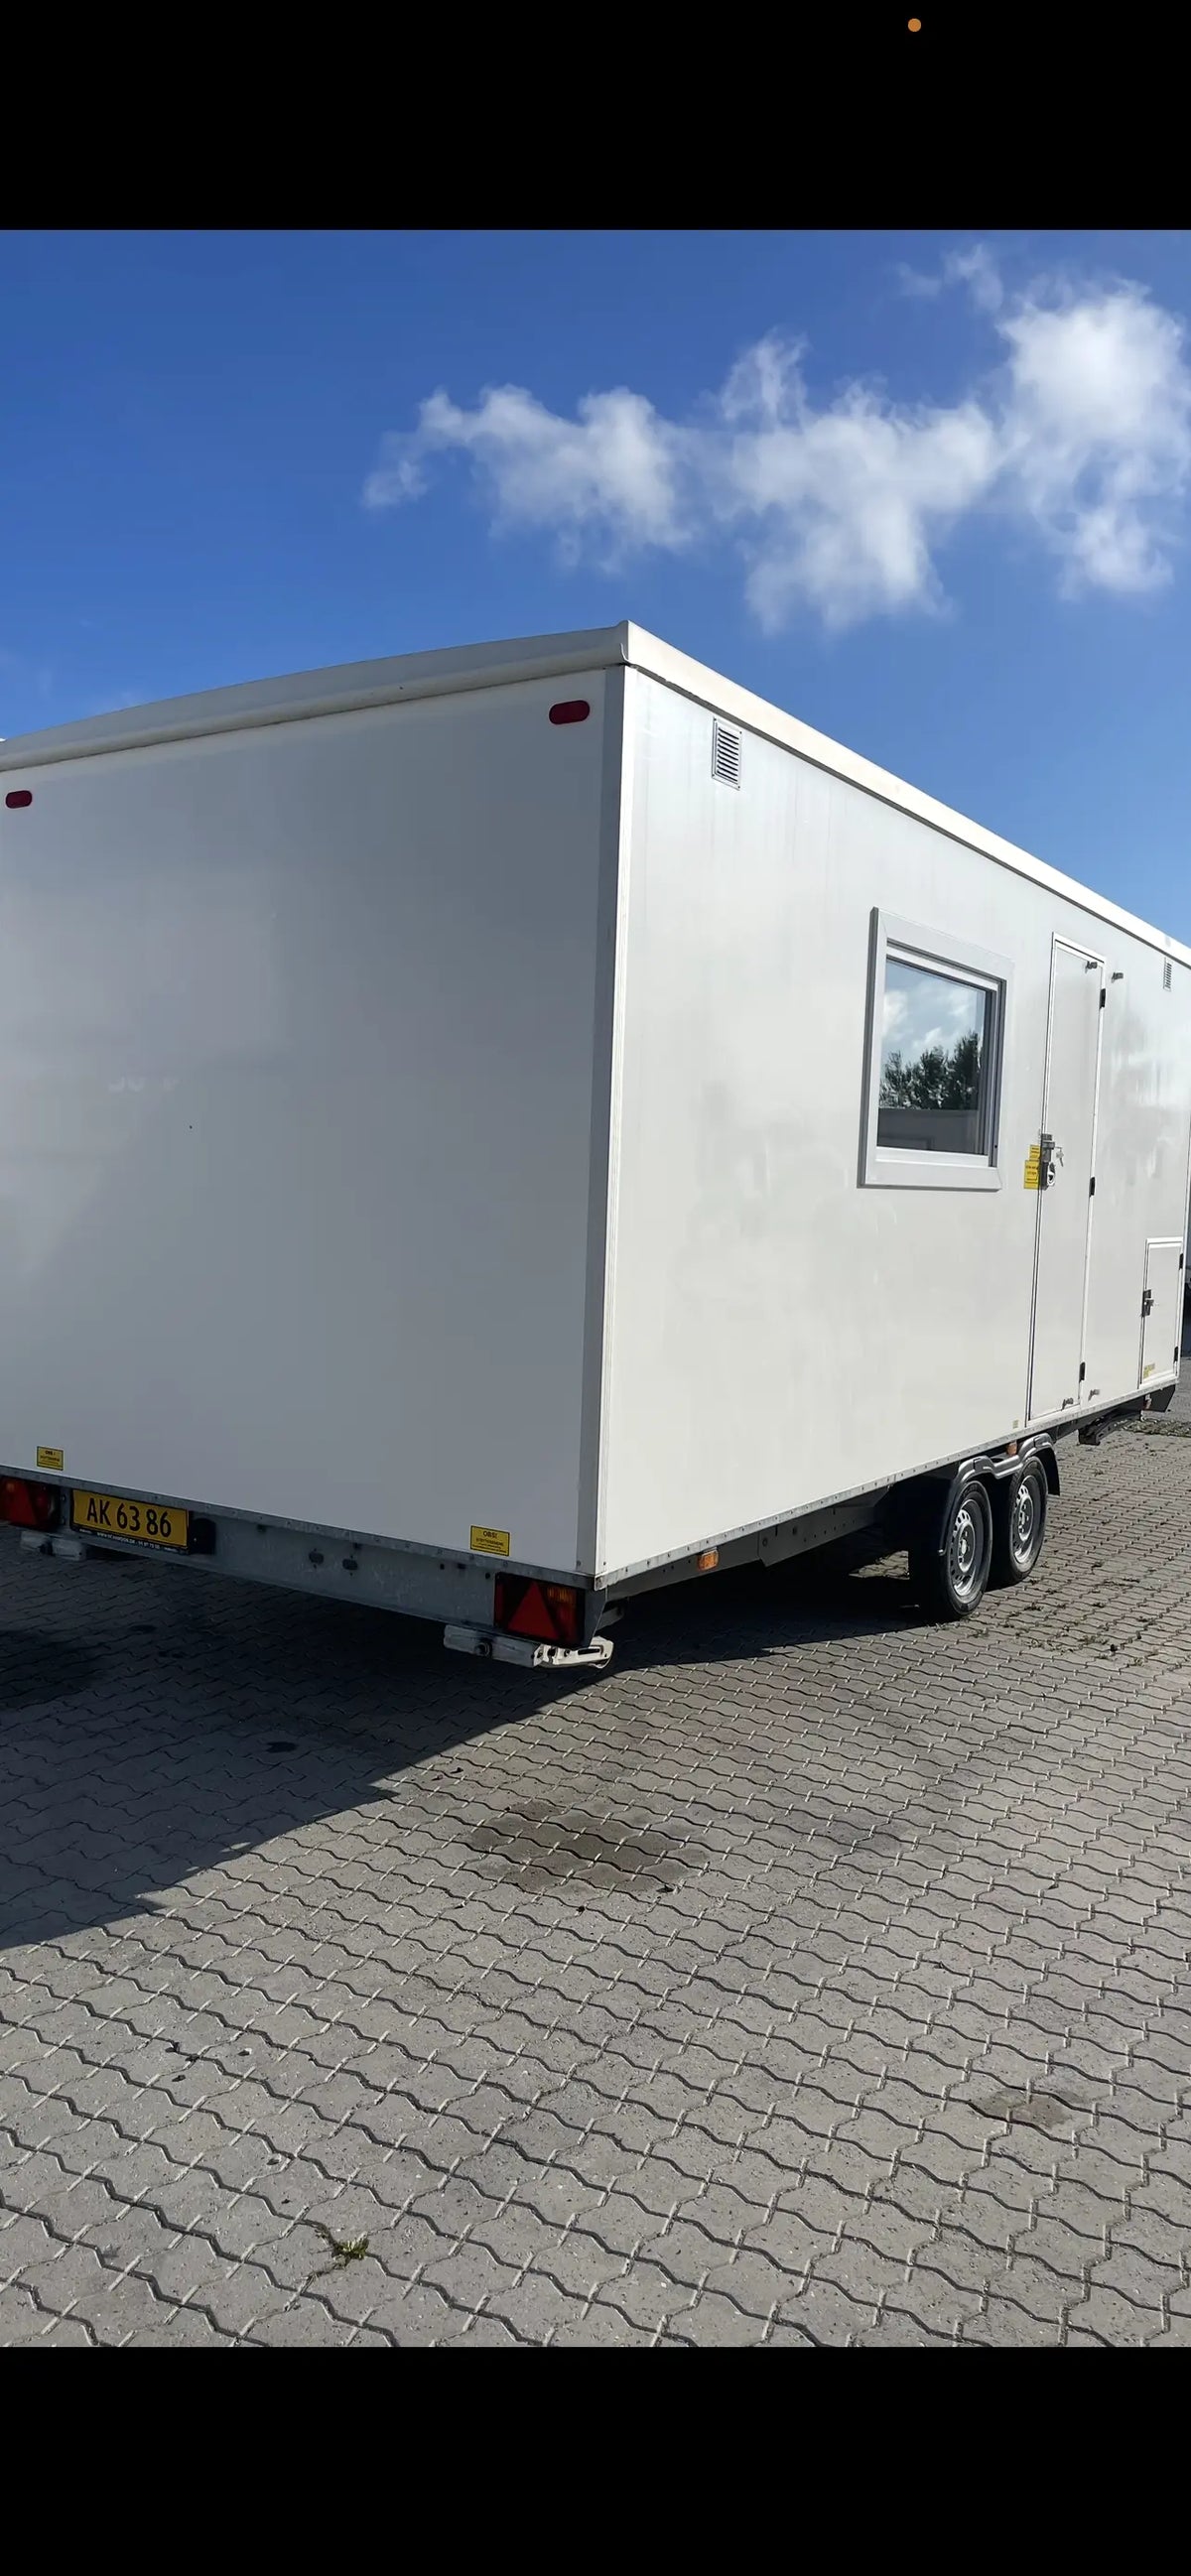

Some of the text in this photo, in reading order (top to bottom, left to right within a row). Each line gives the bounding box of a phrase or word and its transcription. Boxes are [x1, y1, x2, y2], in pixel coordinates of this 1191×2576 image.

[87, 1497, 171, 1537] AK 63 86
